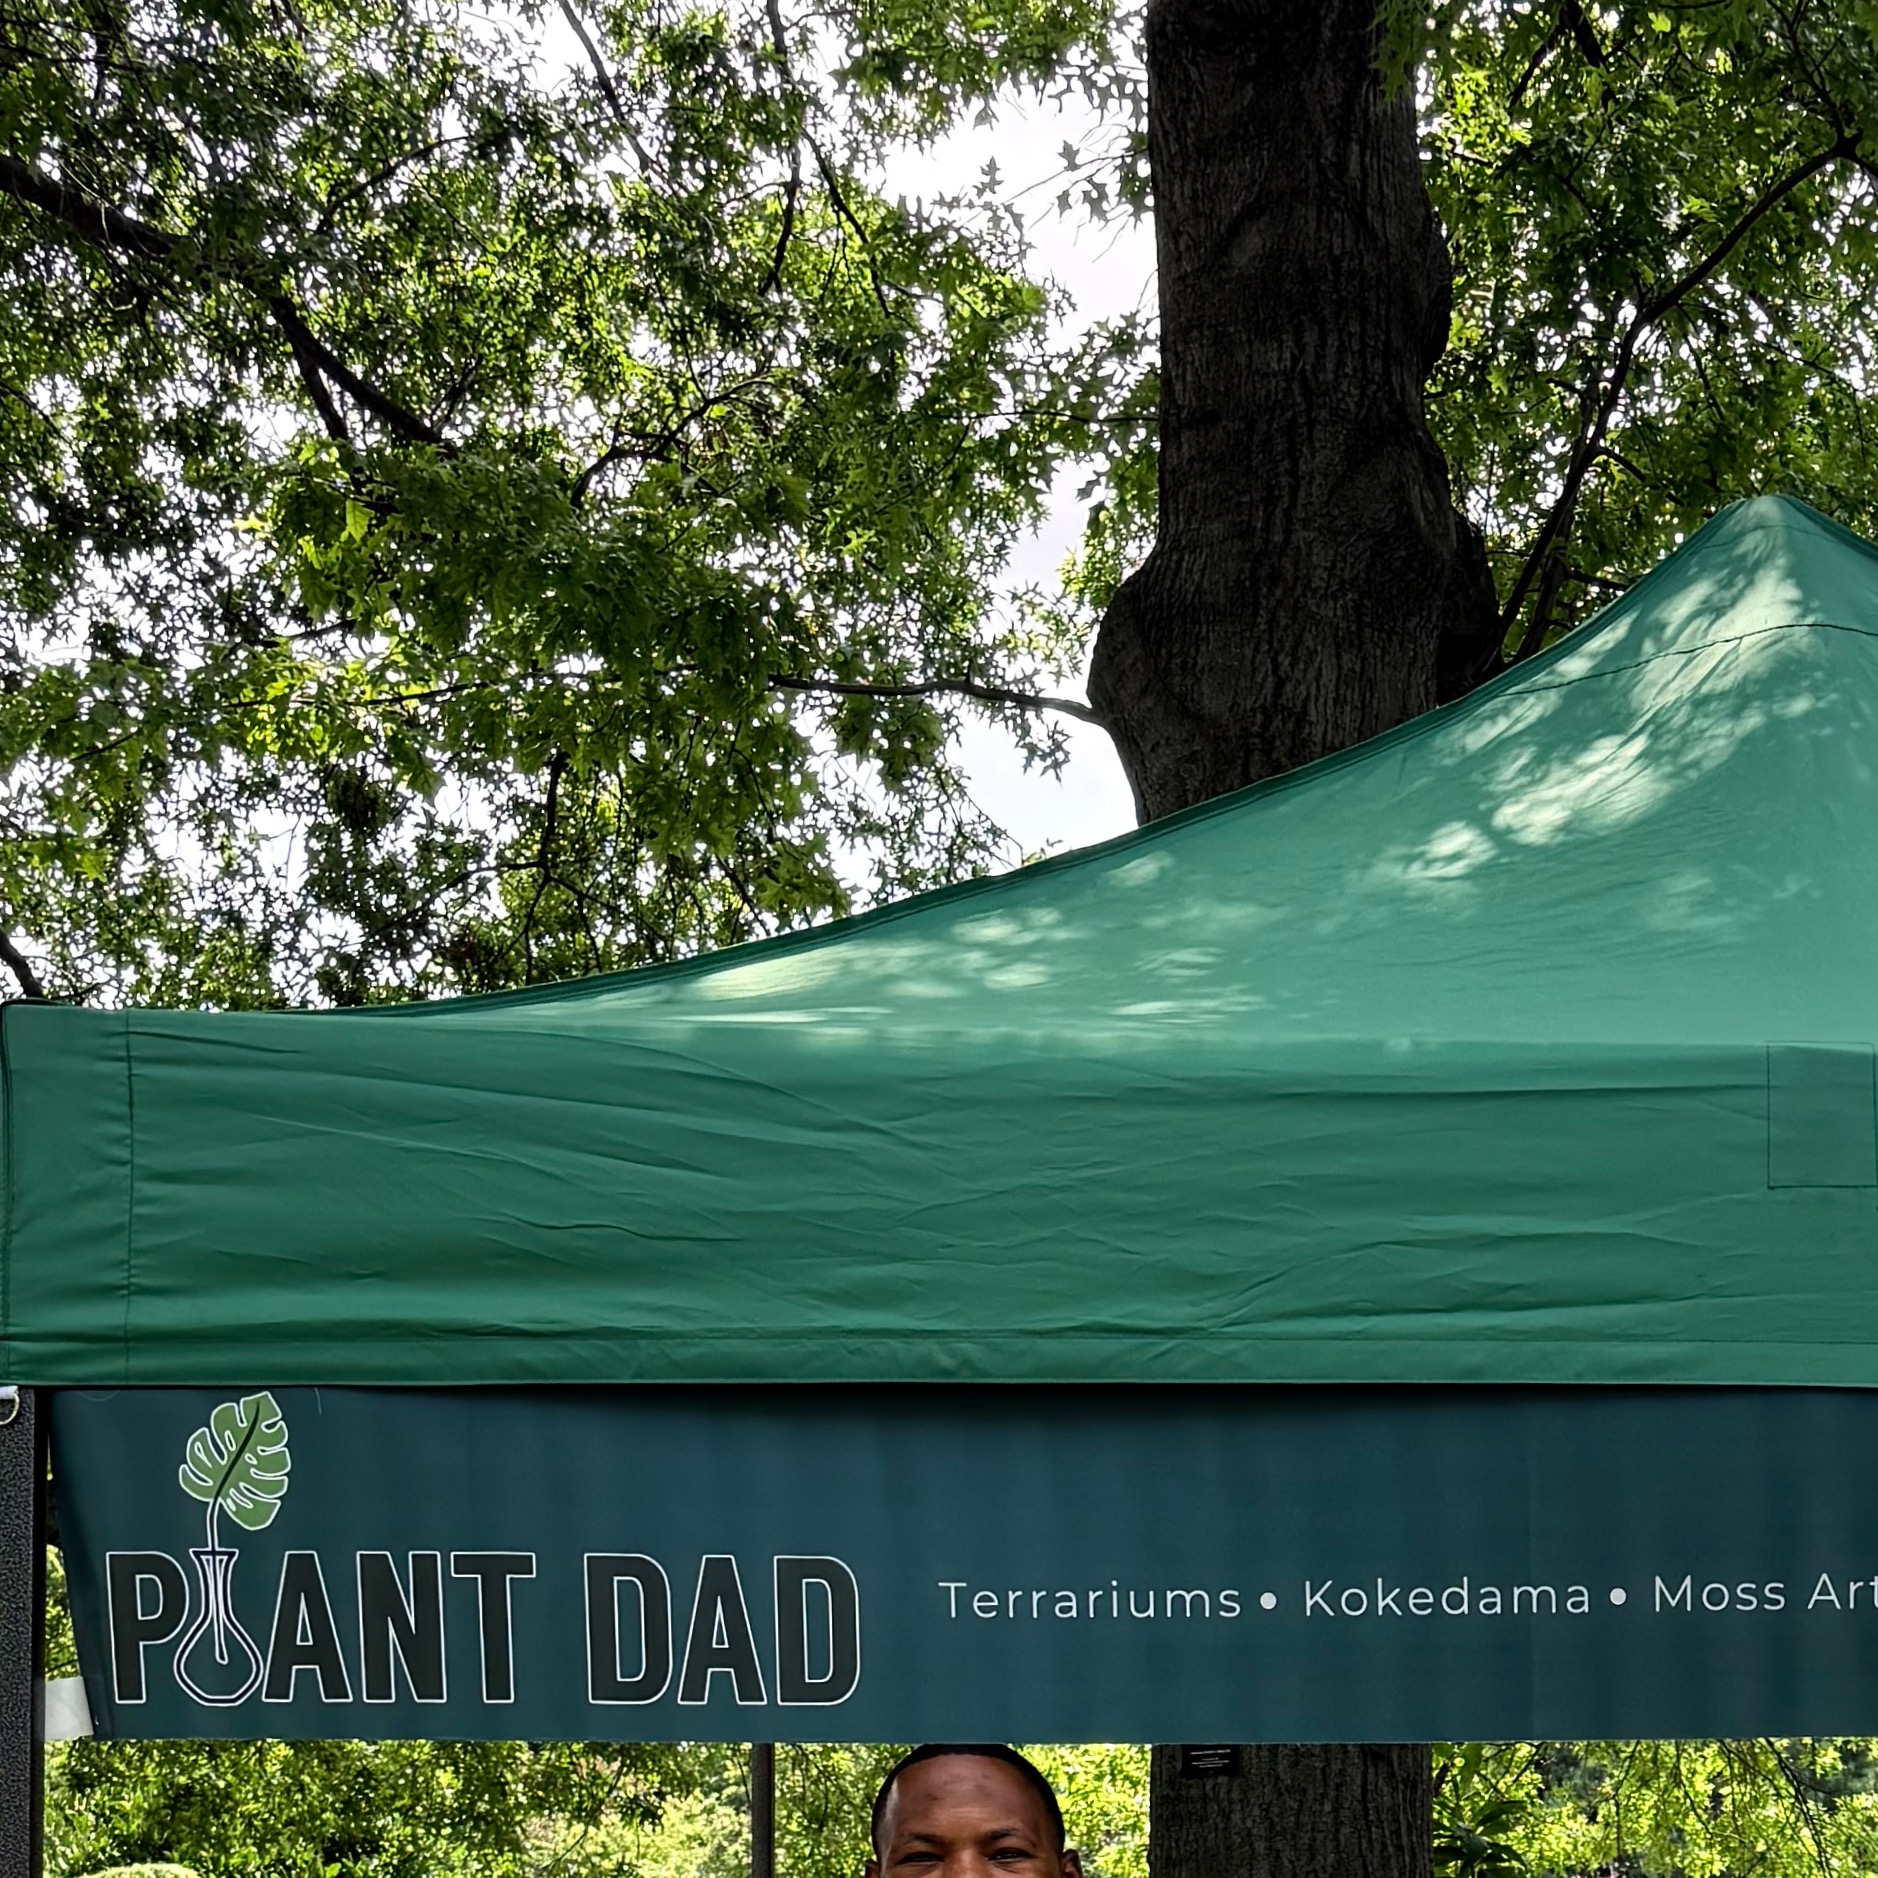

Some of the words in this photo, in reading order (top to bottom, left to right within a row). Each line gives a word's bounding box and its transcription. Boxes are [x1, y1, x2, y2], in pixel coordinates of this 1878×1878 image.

[585, 1553, 861, 1706] DAD
[938, 1579, 1241, 1618] Terrariums
[1304, 1577, 1590, 1616] Kokedama
[1654, 1574, 1785, 1613] Moss
